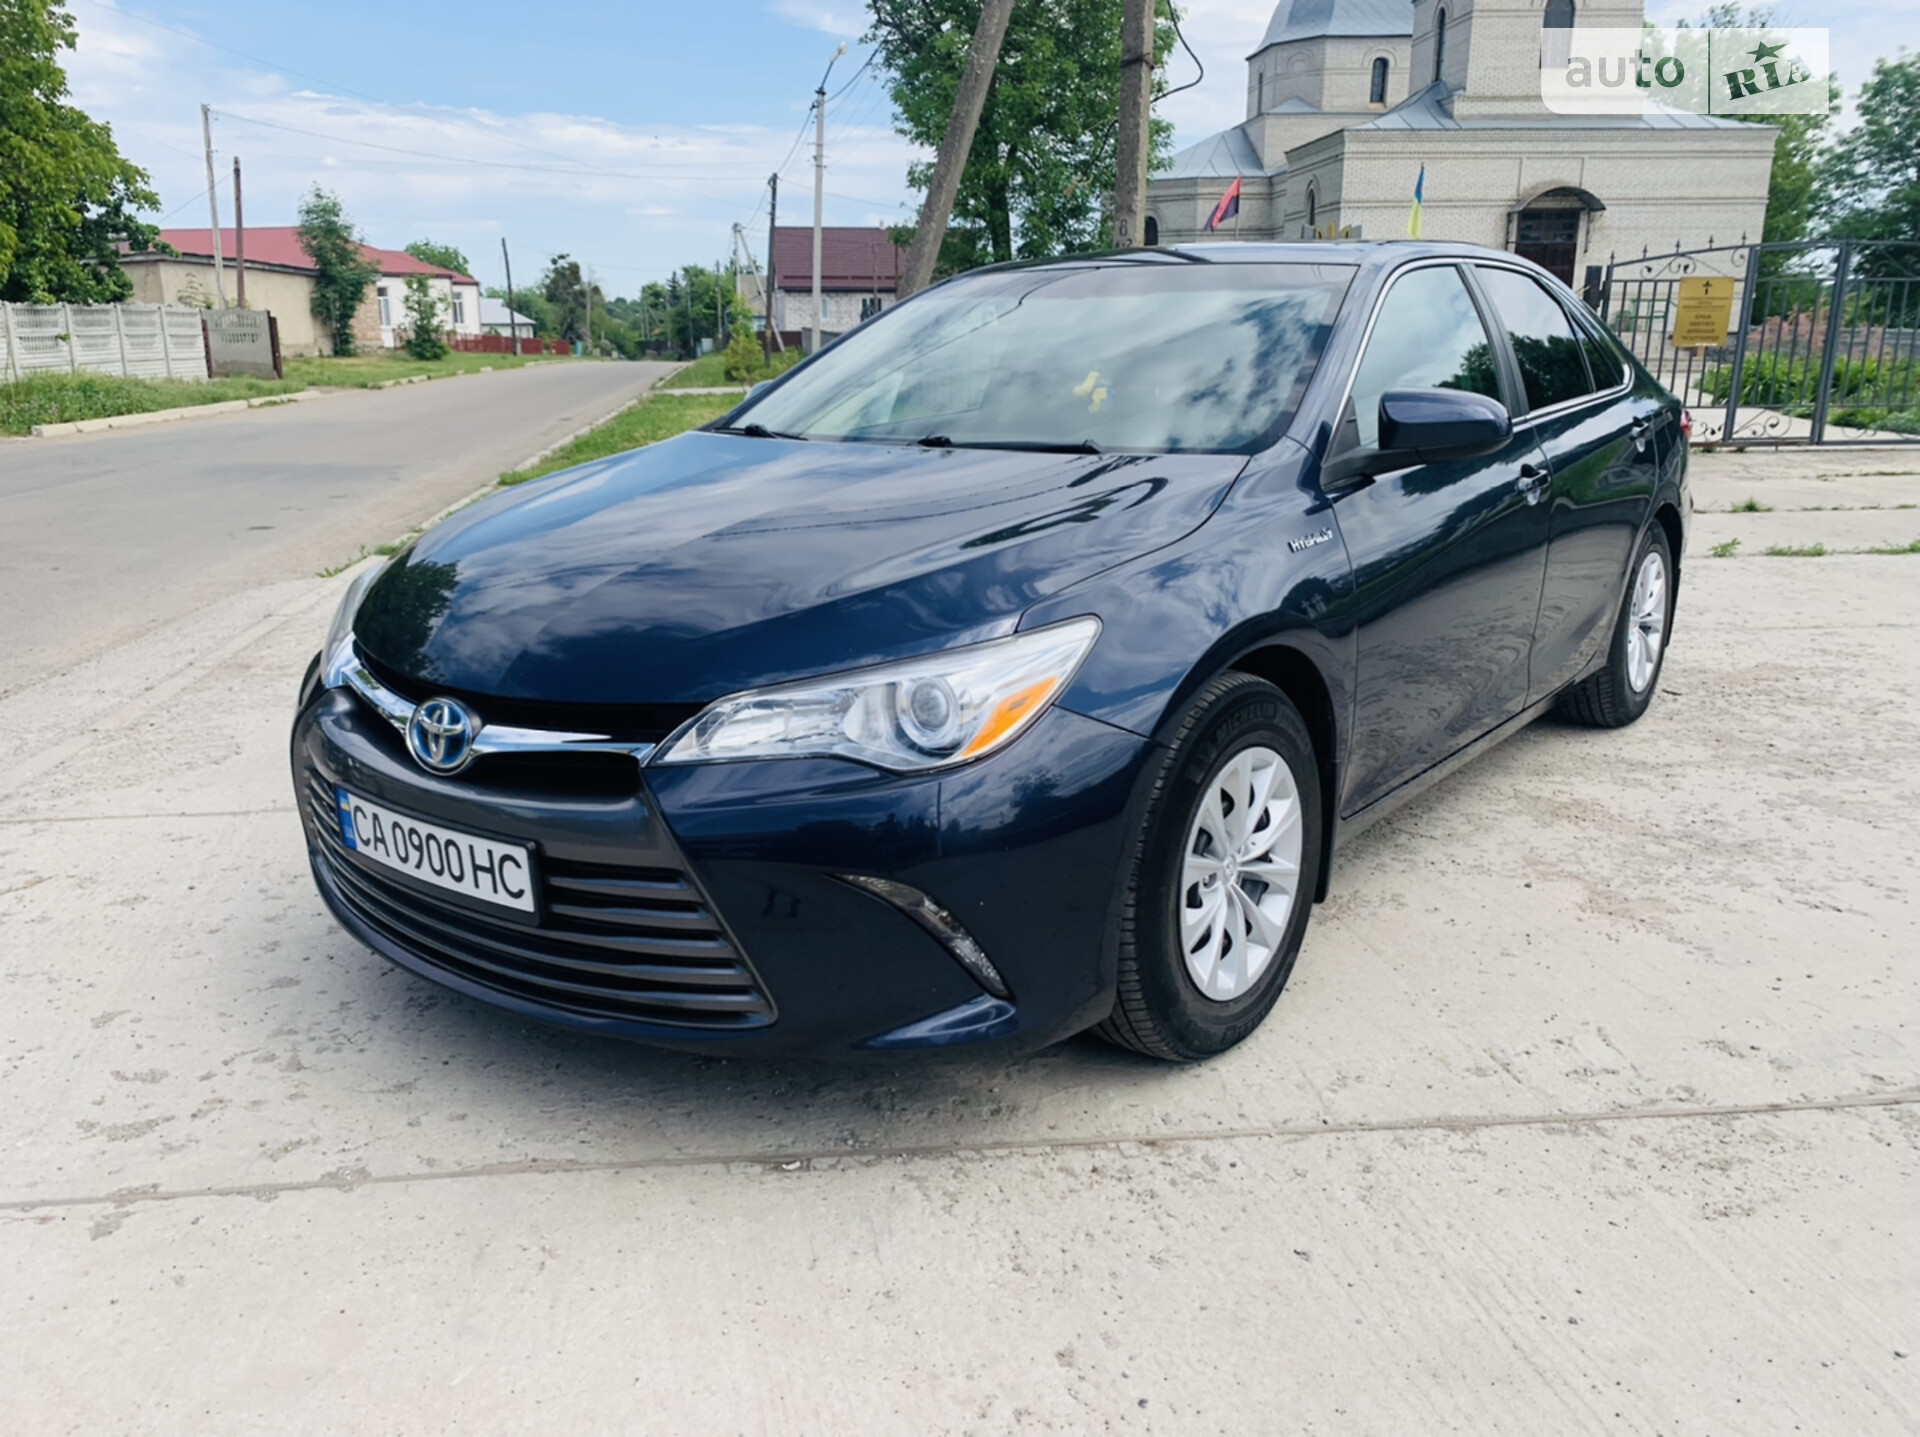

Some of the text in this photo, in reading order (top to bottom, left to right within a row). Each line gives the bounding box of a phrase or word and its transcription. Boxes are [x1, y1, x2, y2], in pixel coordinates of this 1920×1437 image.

[353, 804, 526, 900] CA 0900 HC
